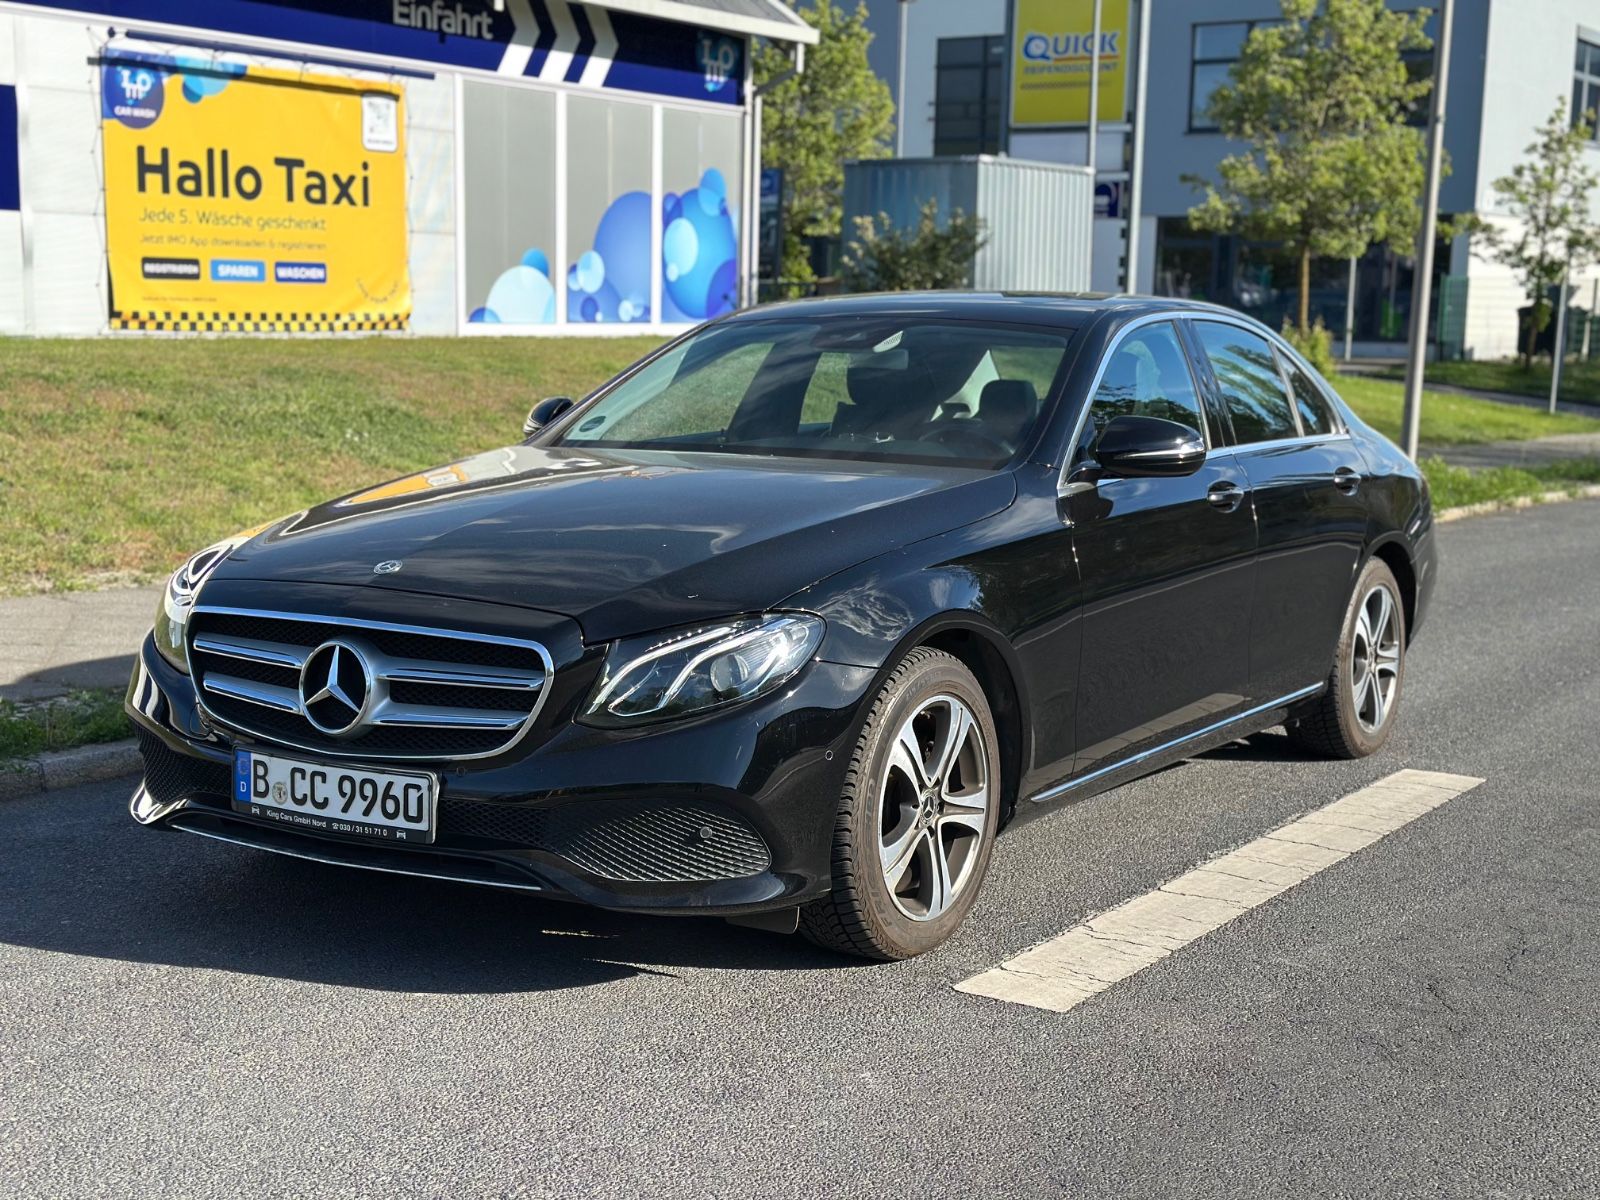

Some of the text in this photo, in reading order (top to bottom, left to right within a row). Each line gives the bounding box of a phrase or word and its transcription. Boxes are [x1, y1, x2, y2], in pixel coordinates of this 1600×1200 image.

[393, 0, 494, 40] Einfahrt
[1023, 32, 1119, 61] QUICK
[114, 105, 156, 118] CAR WASH
[137, 145, 370, 207] Hallo Taxi
[139, 207, 326, 232] Jede 5. Wäsche geschenkt
[140, 234, 164, 244] Jetzt
[190, 235, 208, 247] App
[218, 264, 259, 278] SPAREN
[277, 266, 325, 280] WASCHEN
[240, 781, 247, 793] D
[252, 759, 424, 824] B CC 9960
[266, 809, 280, 821] King
[280, 812, 293, 822] Cars
[293, 815, 311, 825] GmbH
[312, 818, 327, 828] Nord
[339, 823, 351, 832] 030
[356, 825, 363, 834] 31
[364, 826, 372, 835] 51
[374, 827, 381, 835] 71
